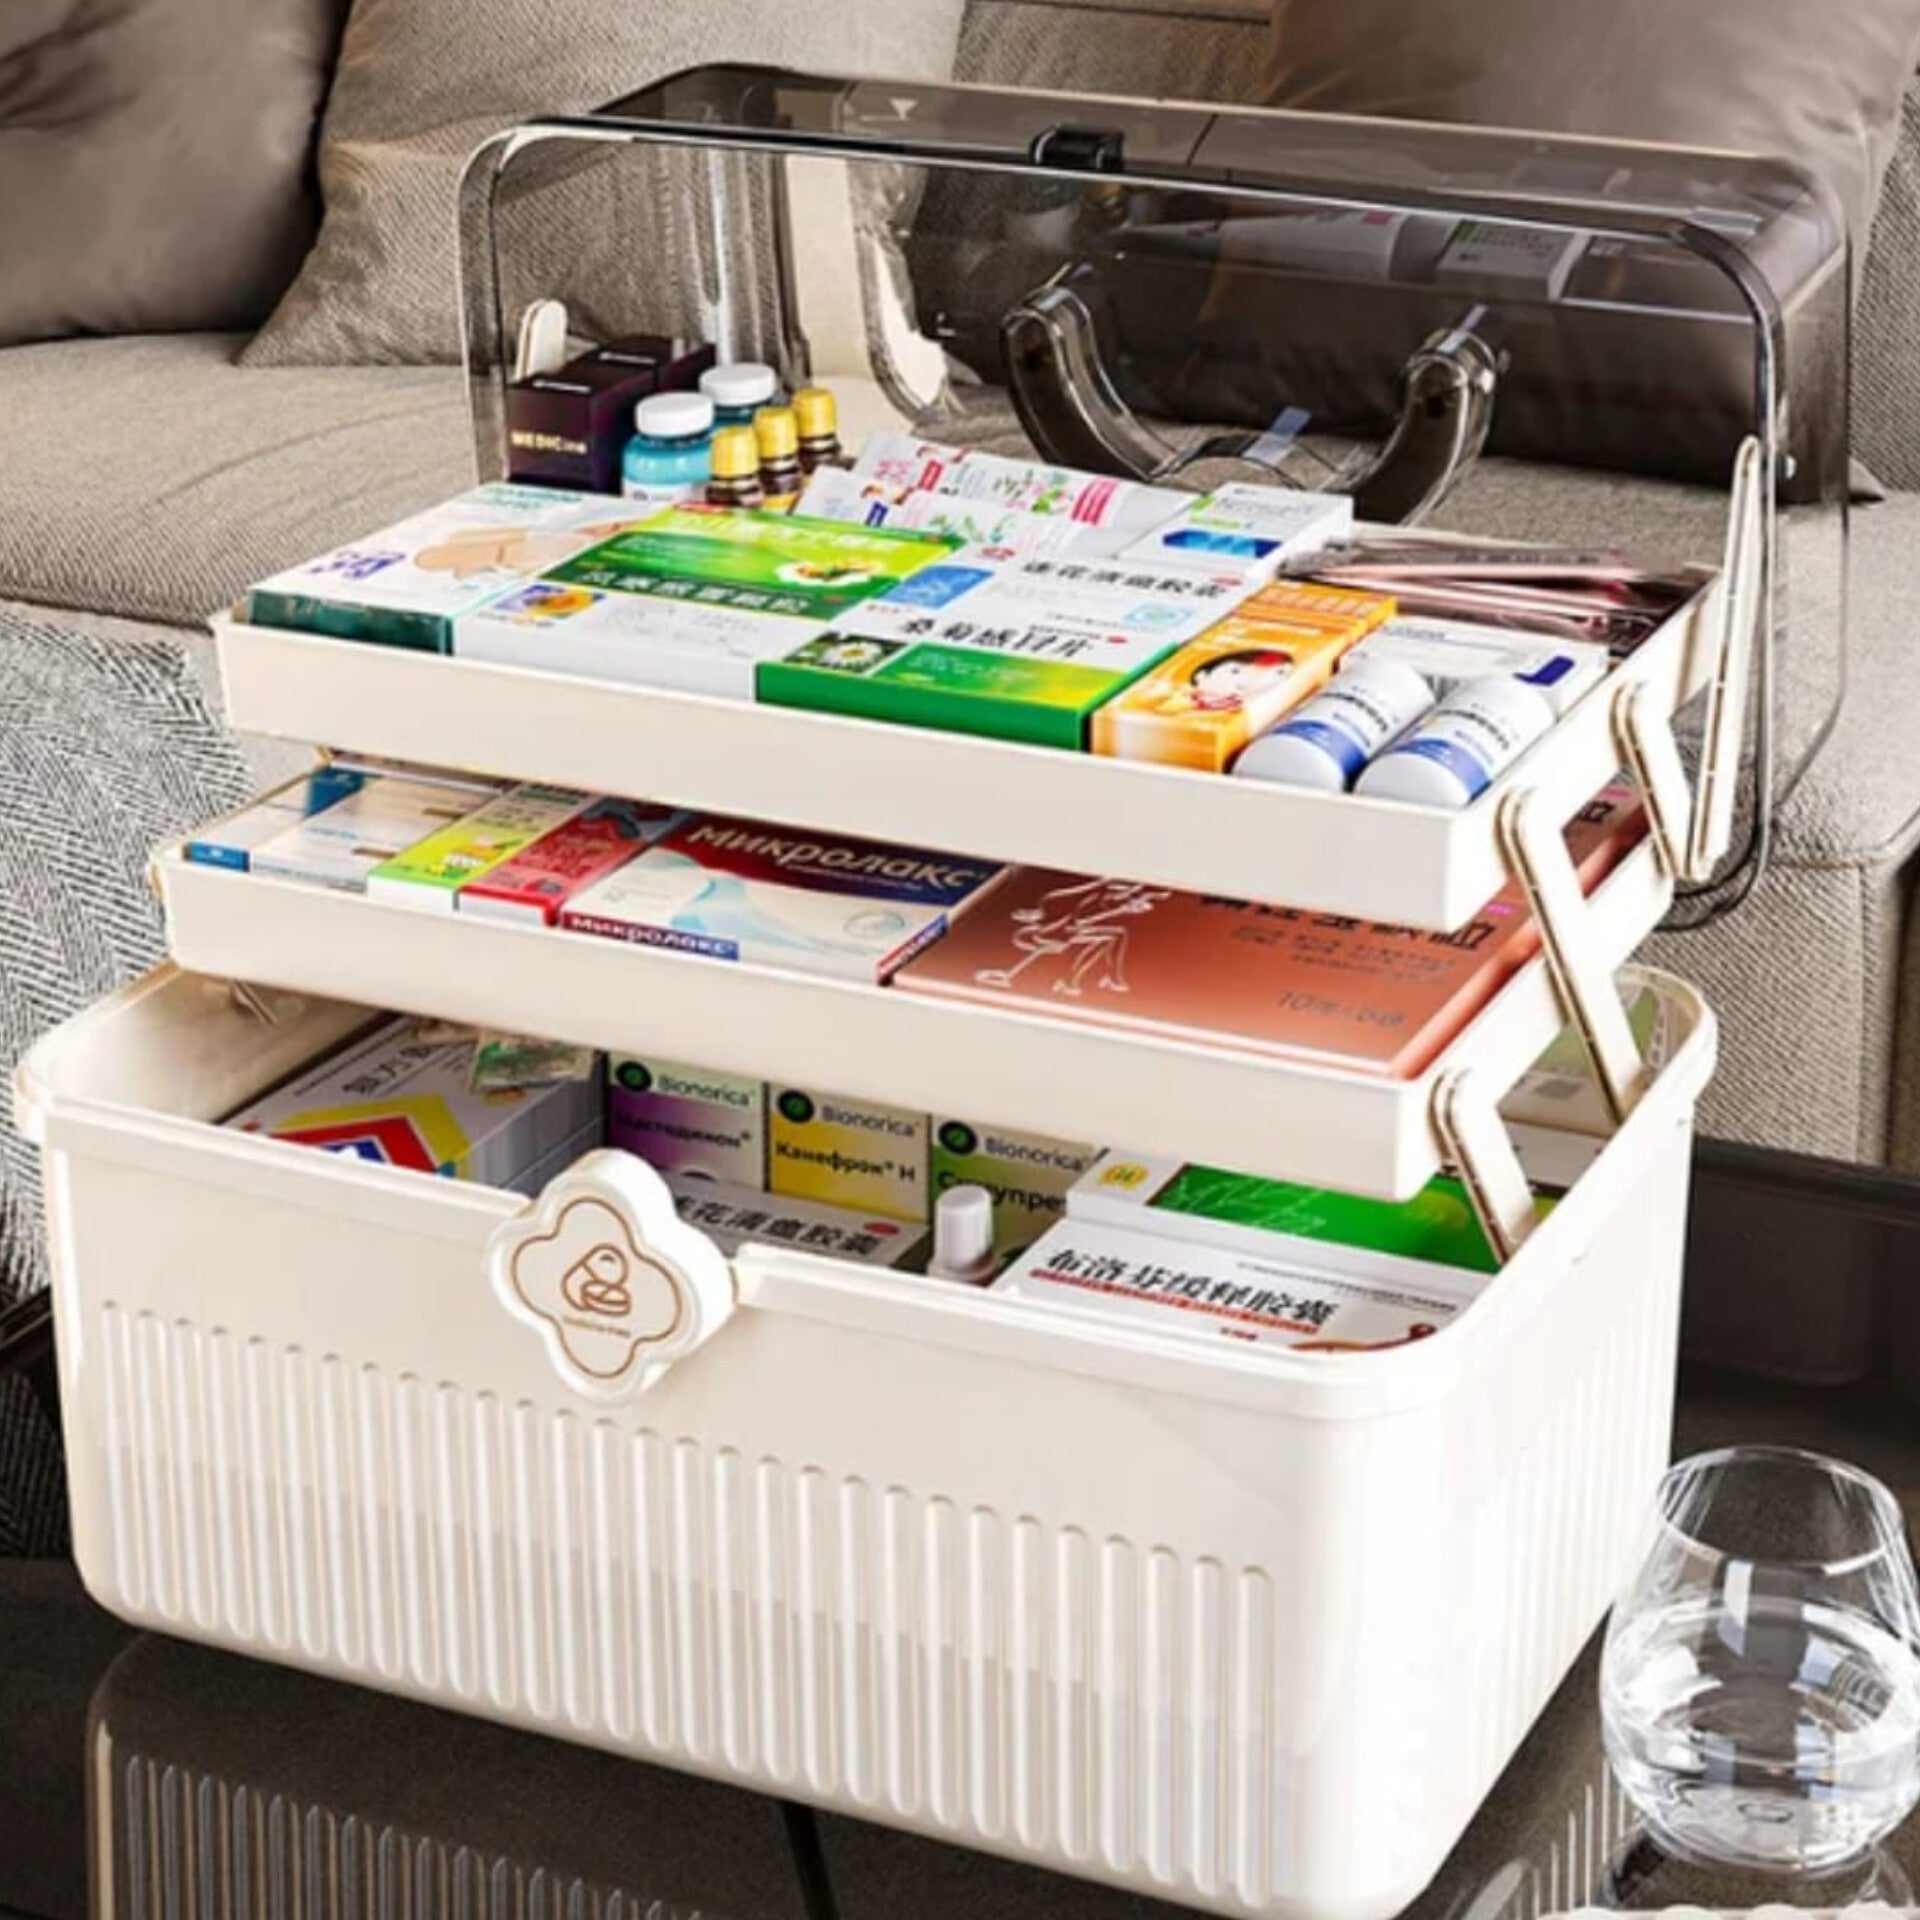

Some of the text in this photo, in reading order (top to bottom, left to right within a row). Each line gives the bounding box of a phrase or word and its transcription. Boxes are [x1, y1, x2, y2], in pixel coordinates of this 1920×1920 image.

[657, 1074, 750, 1106] Bionorica
[822, 1105, 914, 1137] Bionorica
[985, 1137, 1083, 1171] Bionorica
